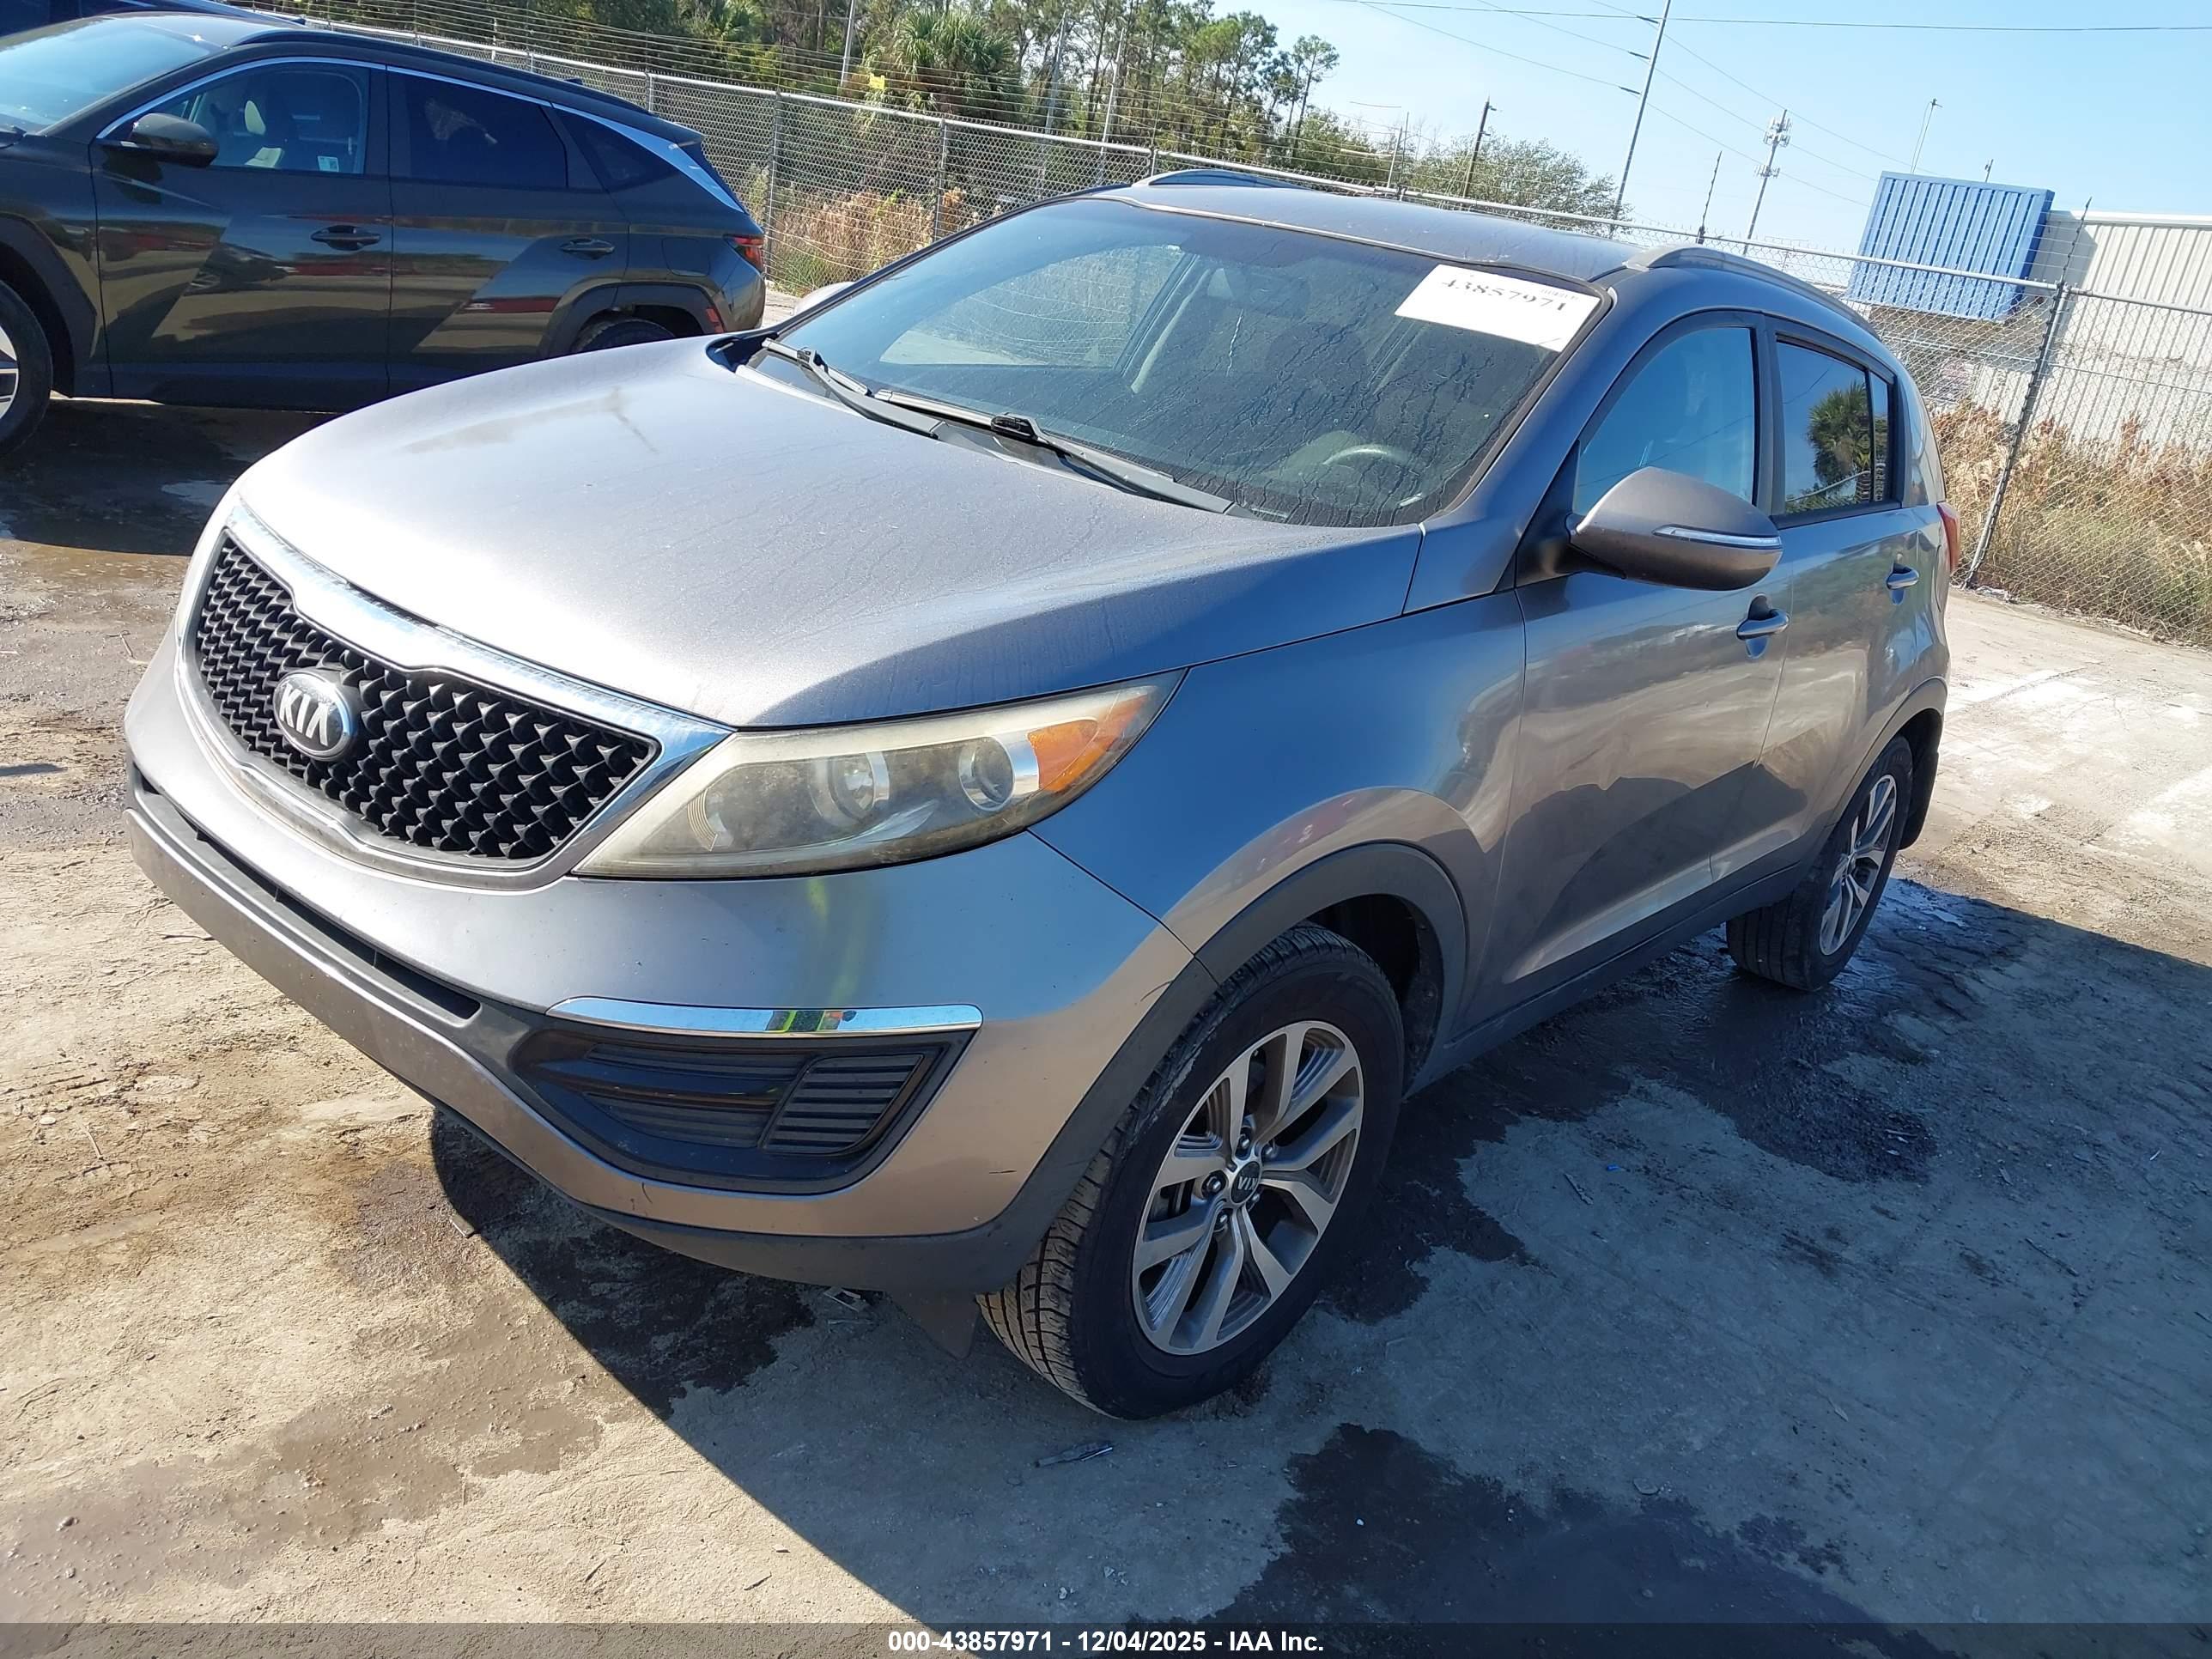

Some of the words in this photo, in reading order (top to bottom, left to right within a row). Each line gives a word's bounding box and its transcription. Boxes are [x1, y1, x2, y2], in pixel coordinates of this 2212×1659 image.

[1441, 279, 1566, 311] 43857971
[279, 683, 331, 746] KIA
[1237, 1176, 1257, 1191] KIA
